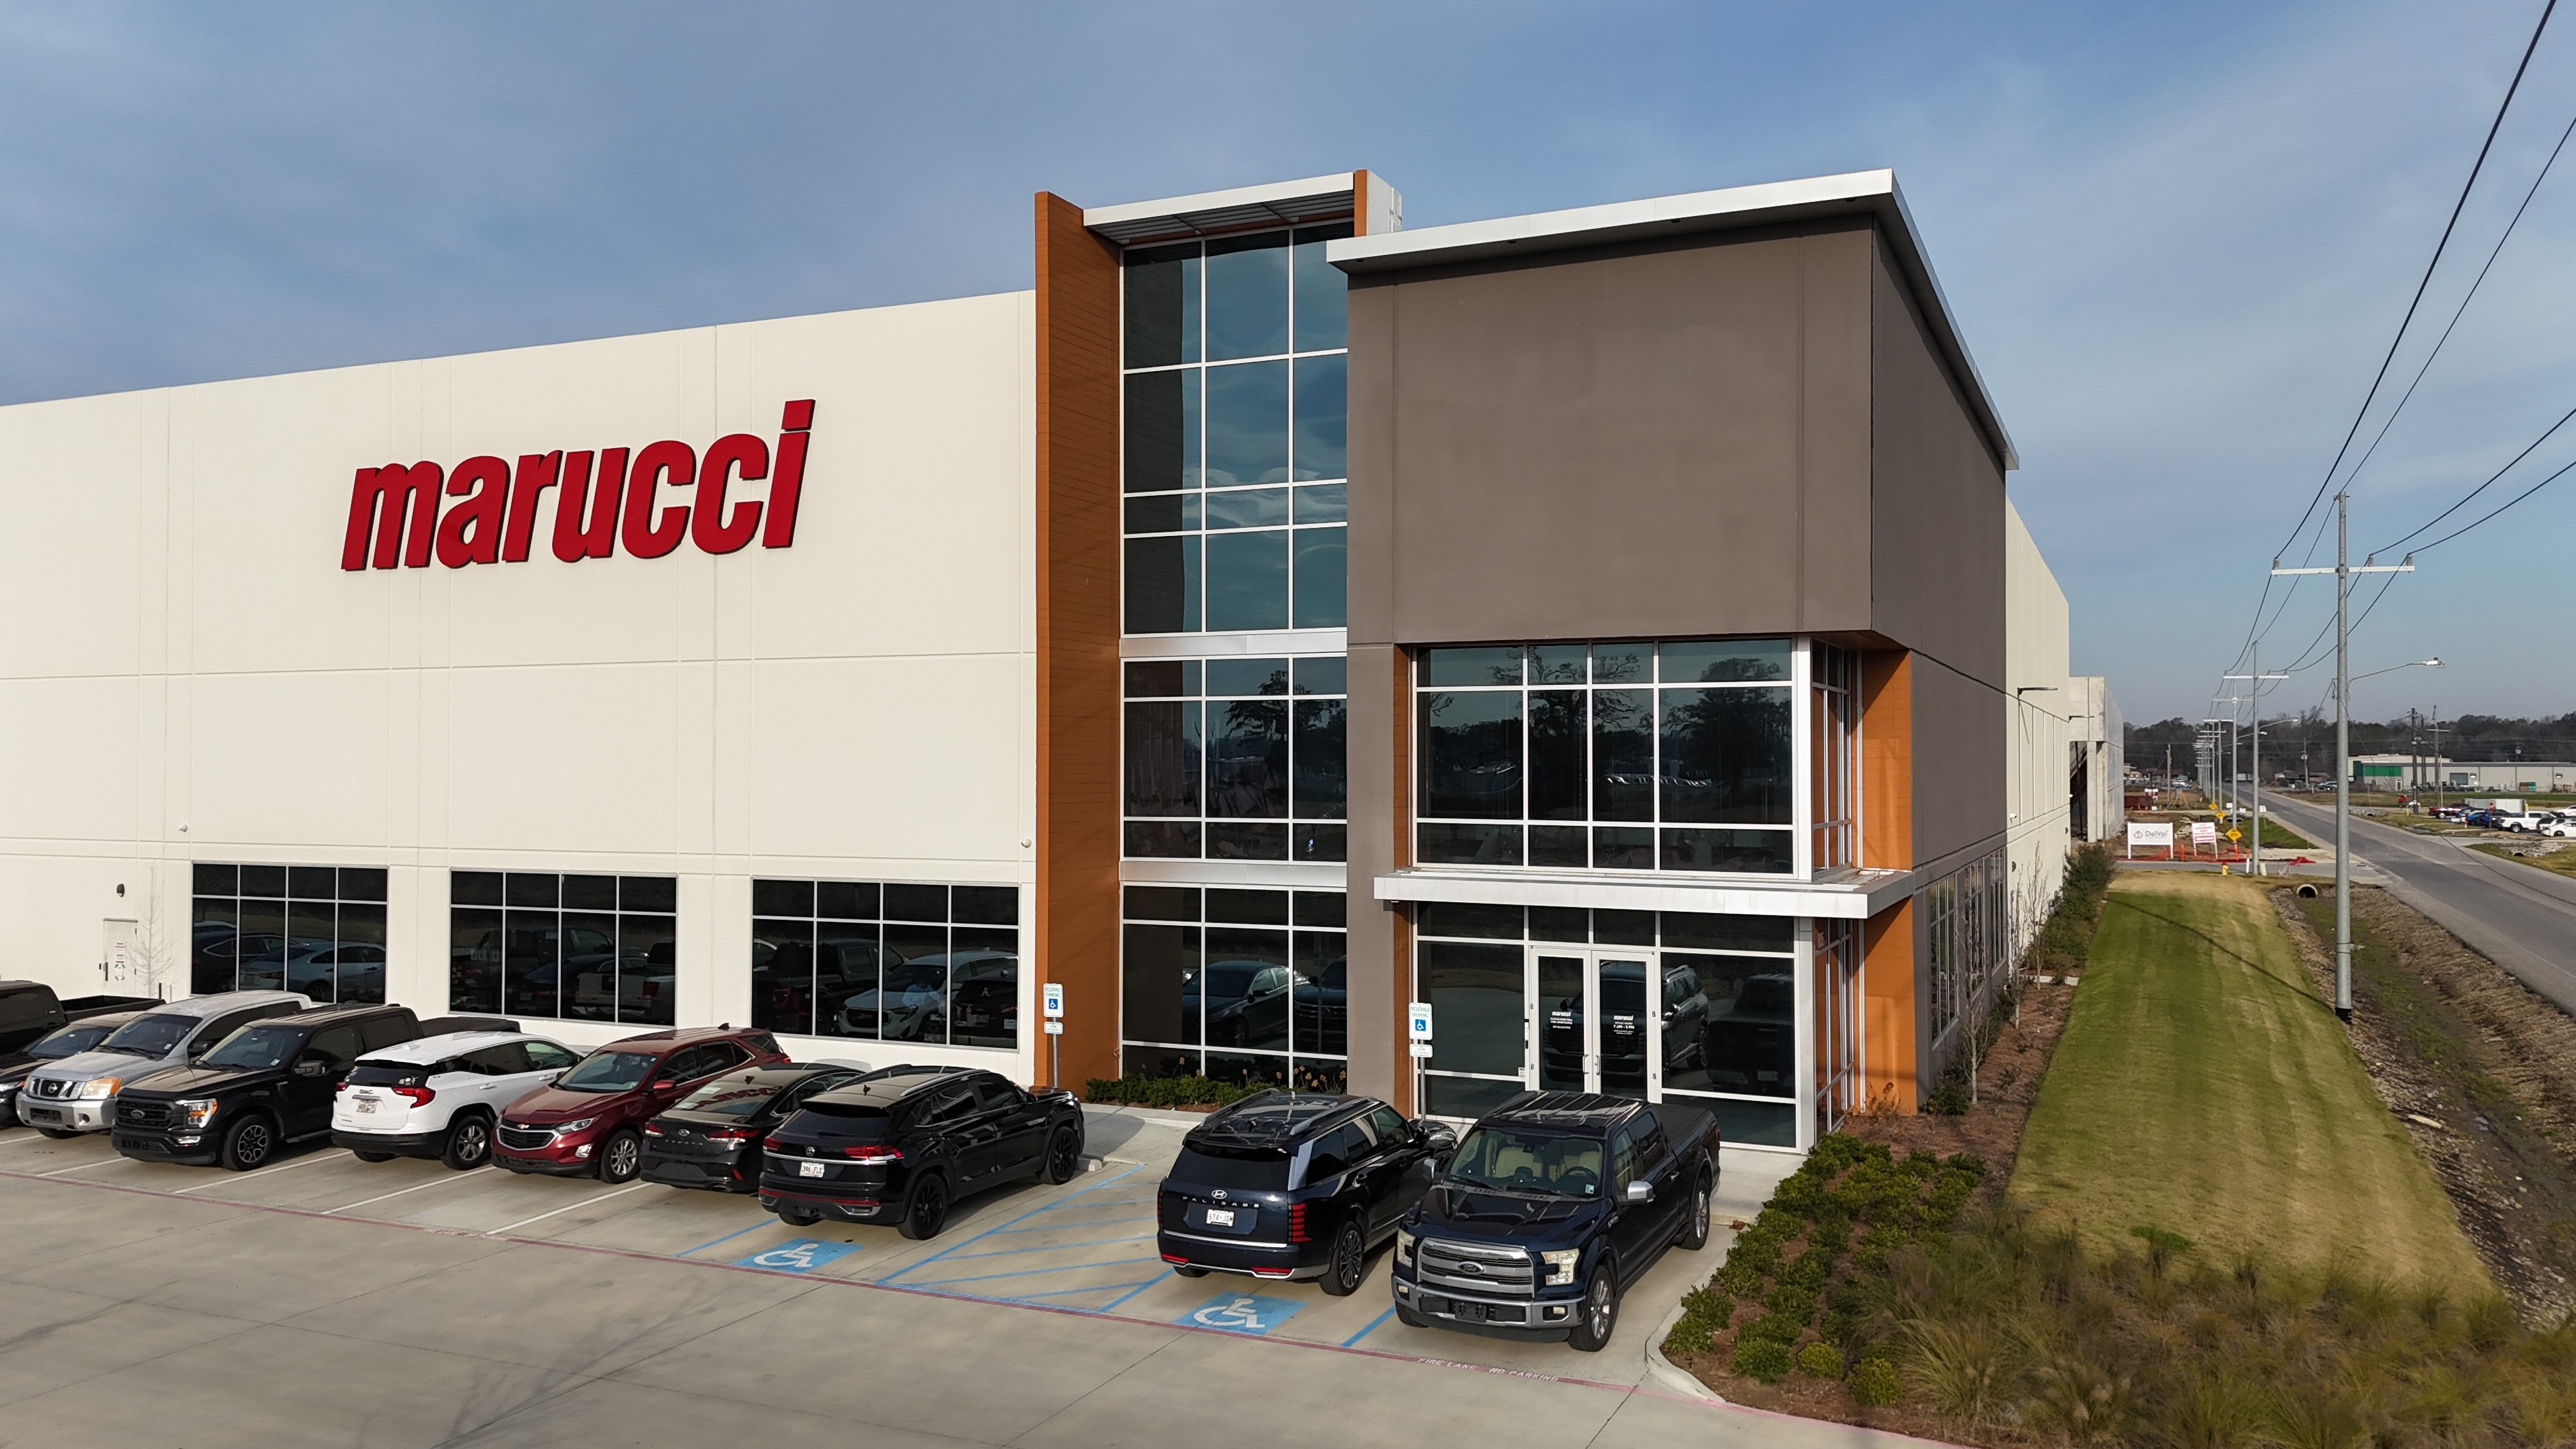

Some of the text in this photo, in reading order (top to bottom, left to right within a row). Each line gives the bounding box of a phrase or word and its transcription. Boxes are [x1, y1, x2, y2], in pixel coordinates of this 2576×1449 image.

[341, 399, 816, 571] marucci
[1183, 1196, 1259, 1208] PALISADE
[1418, 1358, 1445, 1366] FIRE
[1509, 1370, 1558, 1381] PARKING
